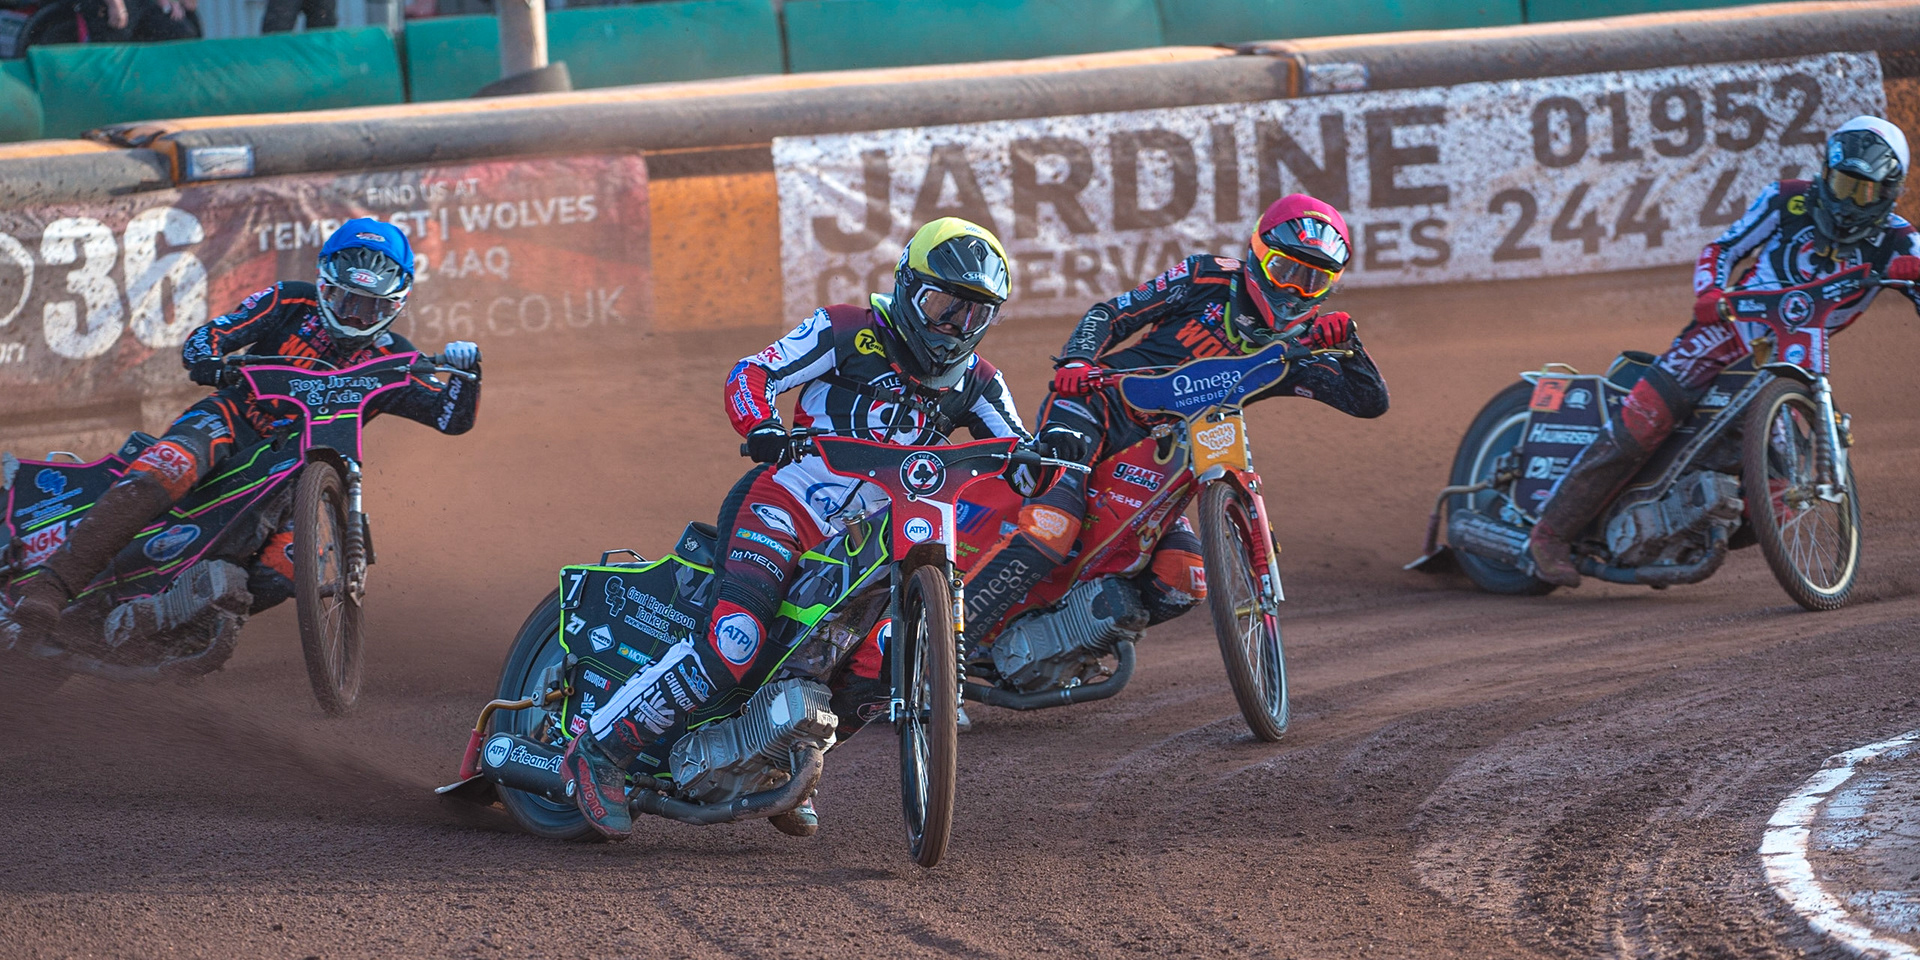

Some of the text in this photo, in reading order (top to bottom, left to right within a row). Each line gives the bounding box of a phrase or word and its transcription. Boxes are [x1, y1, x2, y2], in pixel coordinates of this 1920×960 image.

[1531, 72, 1827, 168] 01952
[367, 178, 480, 205] FIND US AT
[812, 104, 1449, 253] JARDINE
[257, 216, 379, 251] TEMP
[458, 195, 599, 233] WOLVES
[1487, 178, 1671, 263] 244
[437, 246, 511, 280] 4AQ
[404, 284, 628, 345] 36.CO.UK
[23, 526, 63, 557] NGK
[908, 525, 928, 534] ATPI
[750, 532, 791, 560] MOTOREX
[565, 574, 583, 601] 7
[627, 586, 697, 630] Grant Henderson
[635, 605, 670, 632] Tankers
[722, 625, 753, 652] ATPI
[489, 745, 507, 757] ATPI
